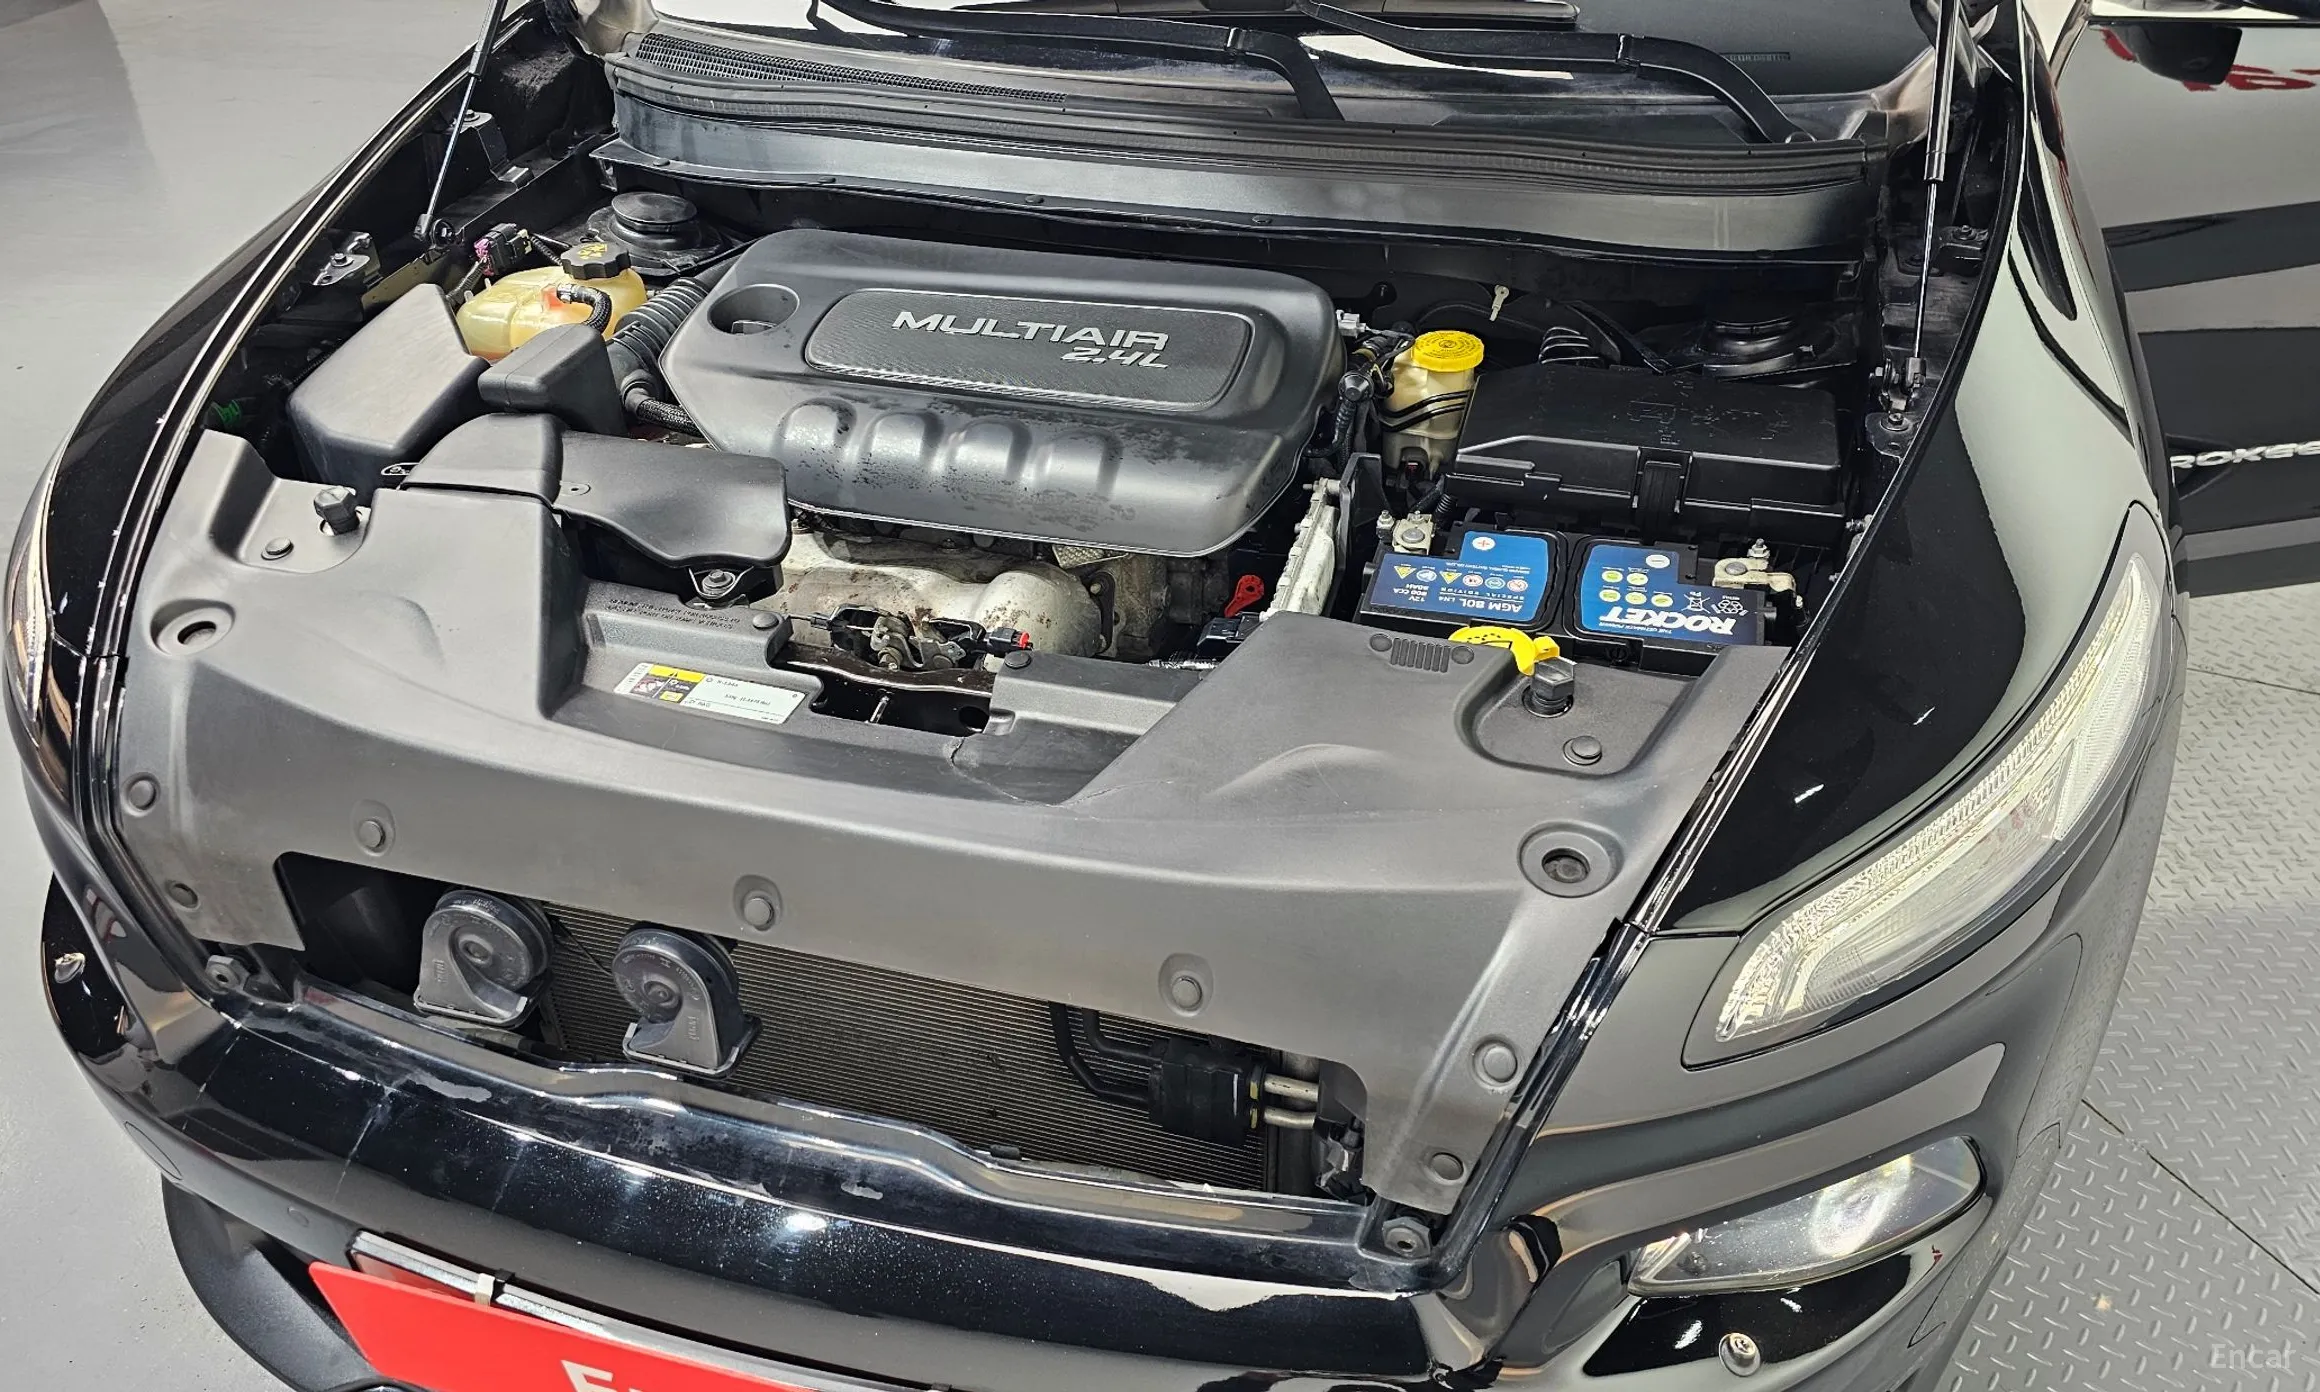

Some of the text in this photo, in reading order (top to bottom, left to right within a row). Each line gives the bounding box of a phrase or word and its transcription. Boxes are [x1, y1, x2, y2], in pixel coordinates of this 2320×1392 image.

[891, 310, 1170, 352] MULTIAIR
[1061, 346, 1169, 369] 2.4L
[1459, 598, 1485, 608] 80L
[1488, 602, 1522, 613] AGM
[1599, 606, 1737, 635] ROCKET
